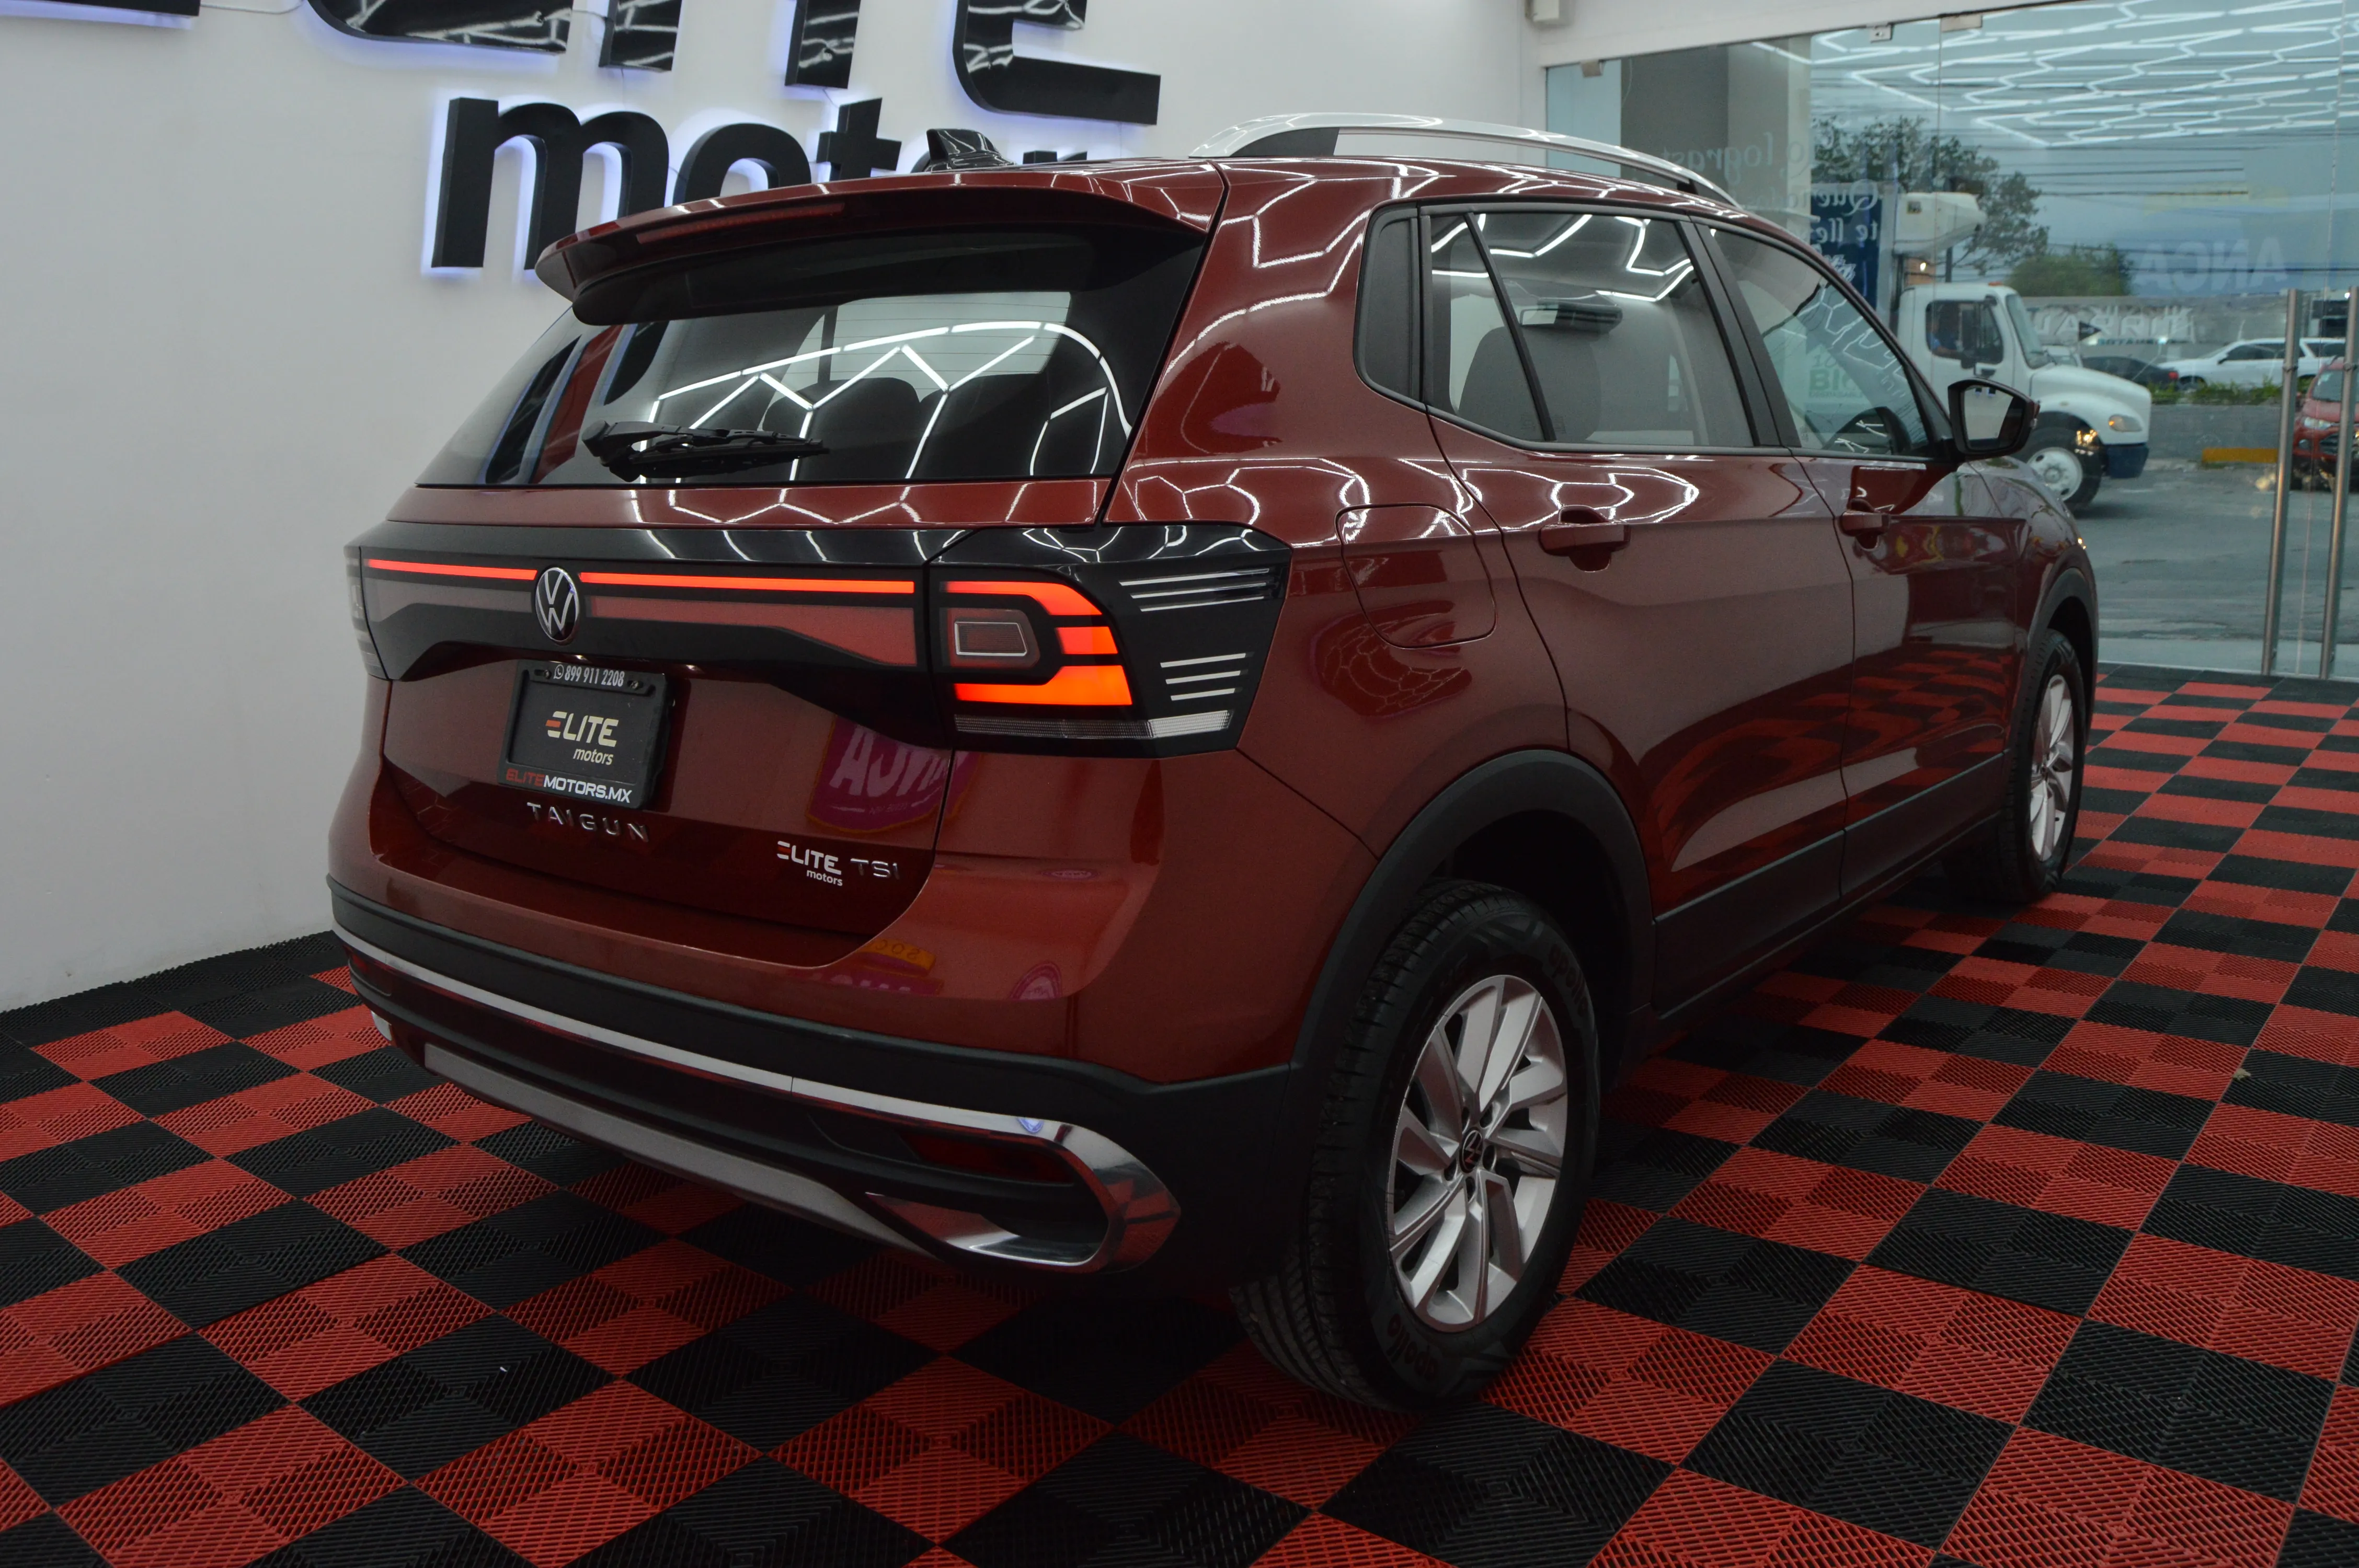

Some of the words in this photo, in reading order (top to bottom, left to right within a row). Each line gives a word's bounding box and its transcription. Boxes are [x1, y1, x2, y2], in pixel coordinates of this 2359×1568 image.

[565, 665, 582, 682] 899
[583, 667, 600, 684] 911
[601, 669, 625, 687] 2208
[545, 710, 619, 747] ELITE
[572, 748, 614, 766] motors
[506, 768, 633, 803] ELITEMOTORS.MX
[526, 801, 649, 843] TAIGUN
[777, 840, 842, 875] ELITE
[850, 858, 900, 880] TSI
[806, 869, 843, 886] motors
[1548, 942, 1589, 1018] apollo
[1387, 1312, 1439, 1381] apollo
